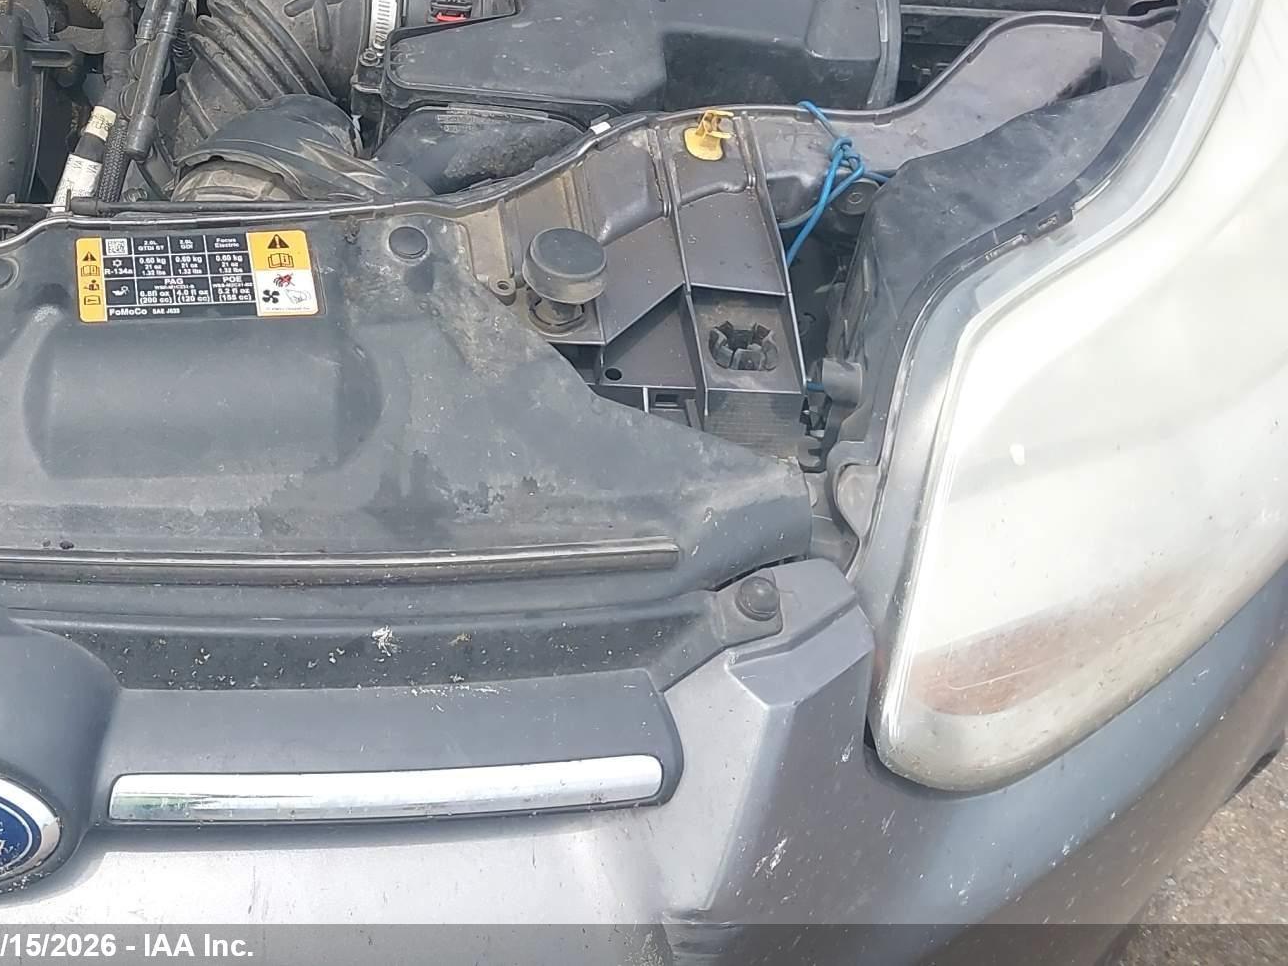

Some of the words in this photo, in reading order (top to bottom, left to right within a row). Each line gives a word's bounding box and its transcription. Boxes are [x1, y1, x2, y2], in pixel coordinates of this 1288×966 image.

[156, 257, 167, 265] kg
[192, 255, 202, 264] kg
[232, 254, 243, 263] kg
[104, 267, 133, 275] R-134a
[222, 275, 242, 283] POE
[159, 296, 173, 304] cc)
[177, 295, 196, 303] (120
[197, 294, 210, 302] cc)
[238, 293, 252, 301] cc)
[108, 307, 148, 316] FoMoCo
